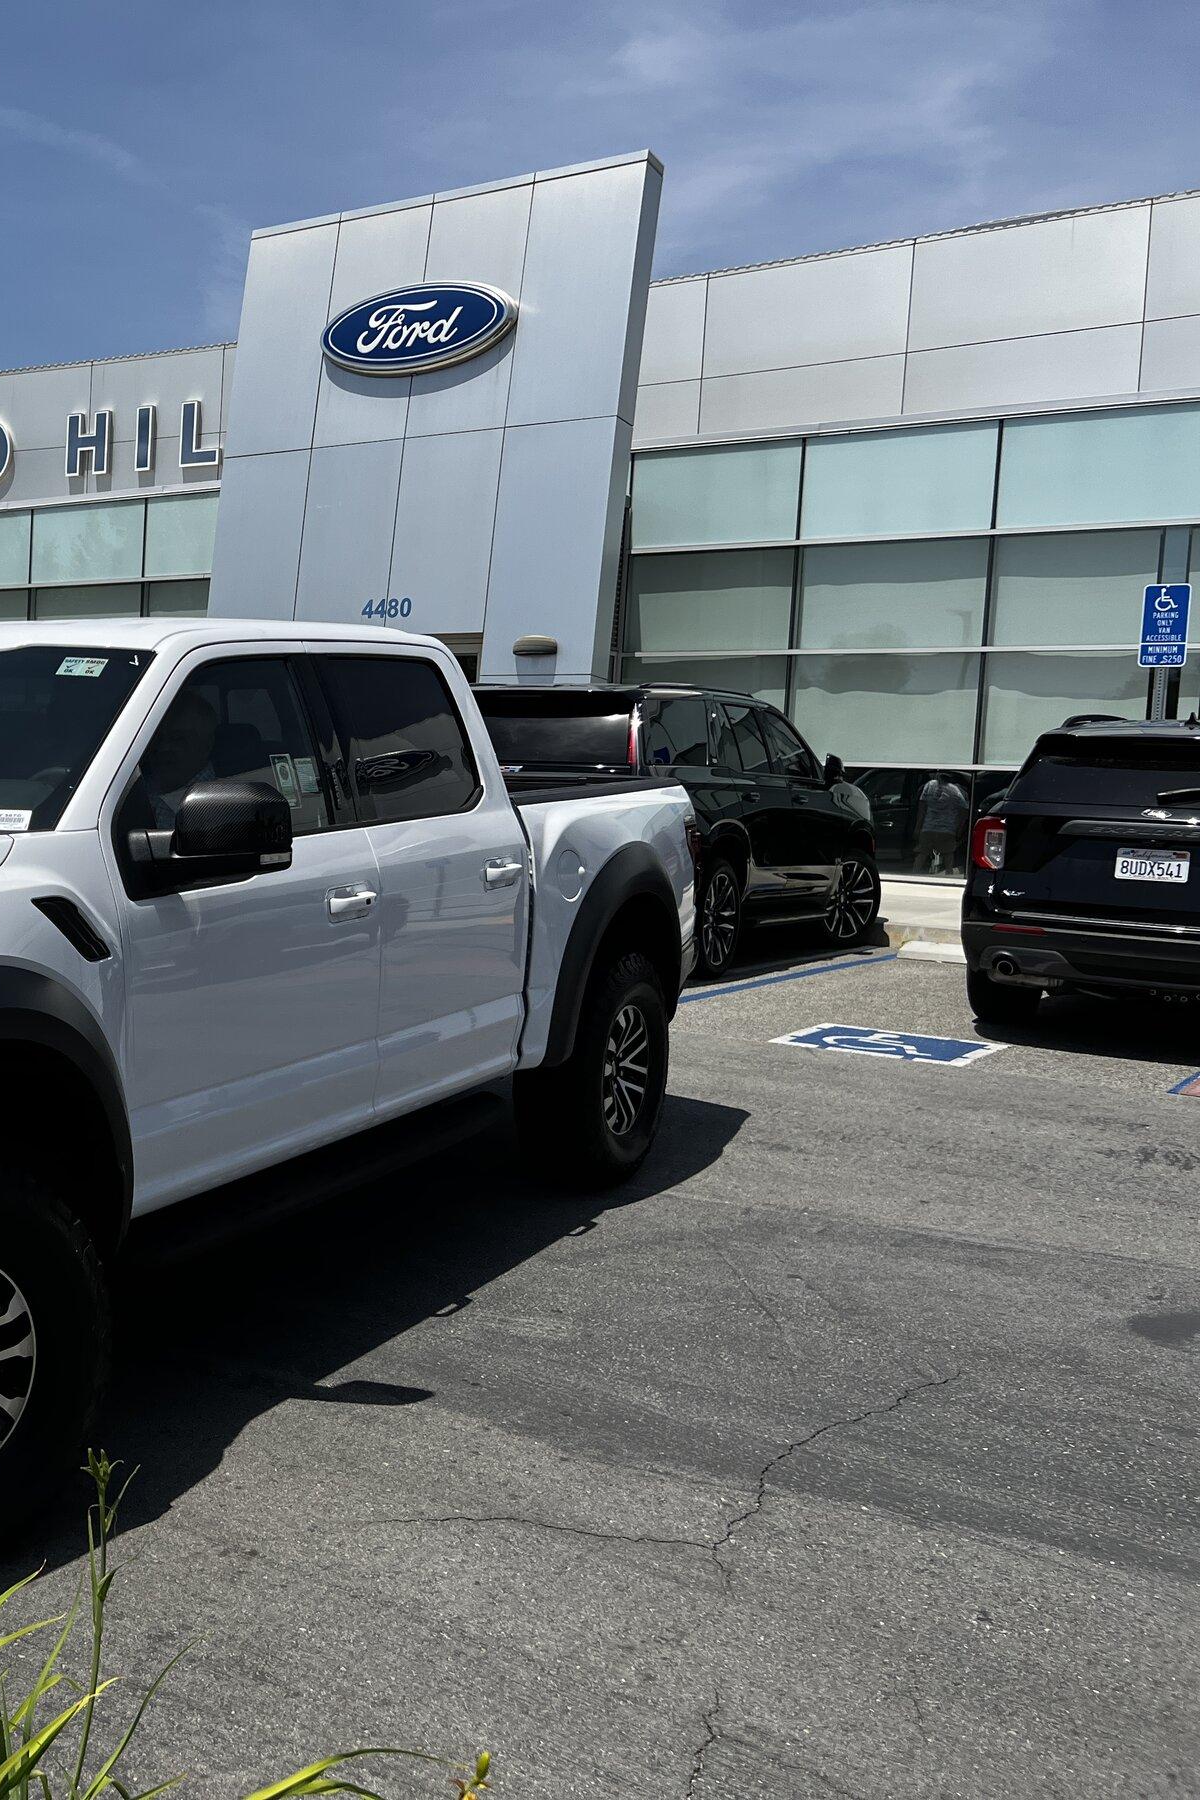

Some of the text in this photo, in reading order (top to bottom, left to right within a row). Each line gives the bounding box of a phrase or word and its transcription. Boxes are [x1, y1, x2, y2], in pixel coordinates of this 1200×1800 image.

[356, 299, 464, 353] Ford
[64, 399, 221, 478] HIL
[361, 597, 412, 618] 4480
[1152, 611, 1179, 619] PARKING
[1157, 619, 1174, 627] ONLY
[1146, 633, 1182, 642] ACCESSIBLE
[1147, 646, 1178, 654] MINIMUM
[1141, 655, 1158, 664] FINE
[1120, 860, 1183, 878] 8UDX541
